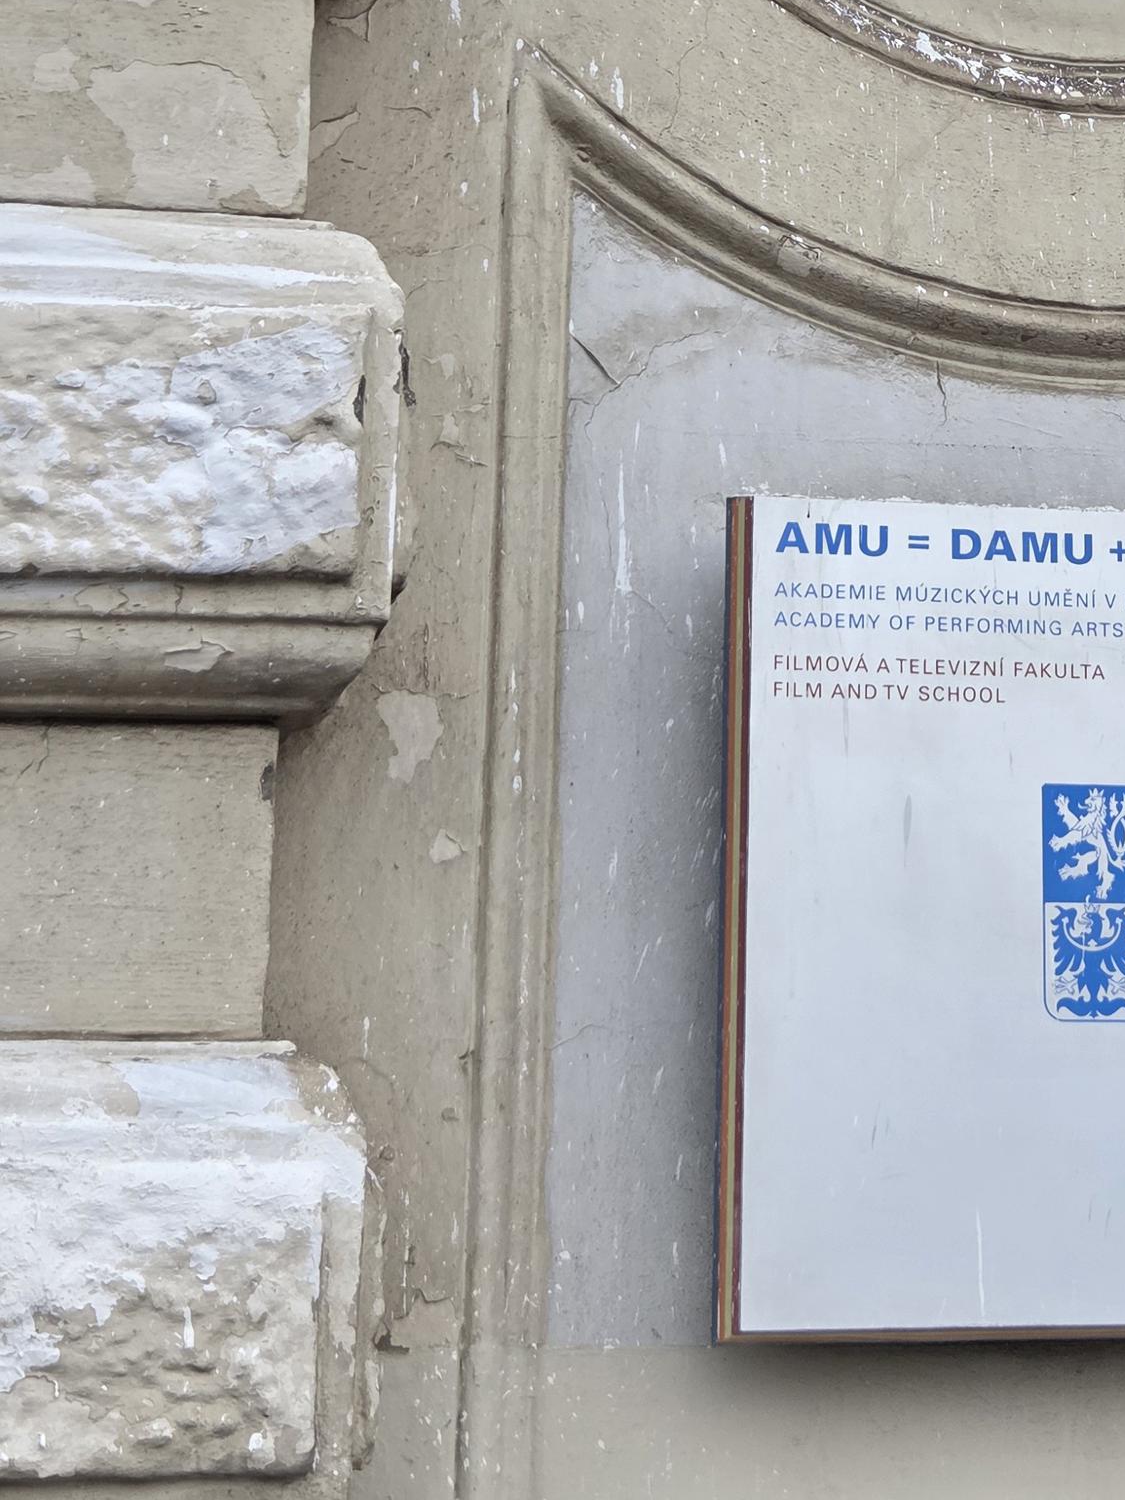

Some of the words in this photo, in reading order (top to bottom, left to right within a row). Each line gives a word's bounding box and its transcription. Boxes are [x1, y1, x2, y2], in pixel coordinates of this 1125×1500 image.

[776, 521, 889, 557] AMU
[908, 535, 930, 550] =
[951, 528, 1094, 565] DAMU
[774, 582, 886, 601] AKADEMIE
[895, 583, 1019, 606] MÚZICKÝCH
[1028, 589, 1096, 609] UMĚNÍ
[1104, 594, 1117, 609] V
[774, 611, 880, 630] ACADEMY
[889, 615, 916, 631] OF
[925, 616, 1062, 636] PERFORMING
[1071, 621, 1124, 638] ARTS
[773, 653, 868, 673] FILMOVÁ
[876, 658, 890, 673] A
[895, 657, 1004, 677] TELEVIZNÍ
[1013, 662, 1105, 680] FAKULTA
[773, 682, 823, 699] FILM
[831, 683, 878, 700] AND
[883, 684, 909, 701] TV
[918, 686, 1006, 704] SCHOOL
